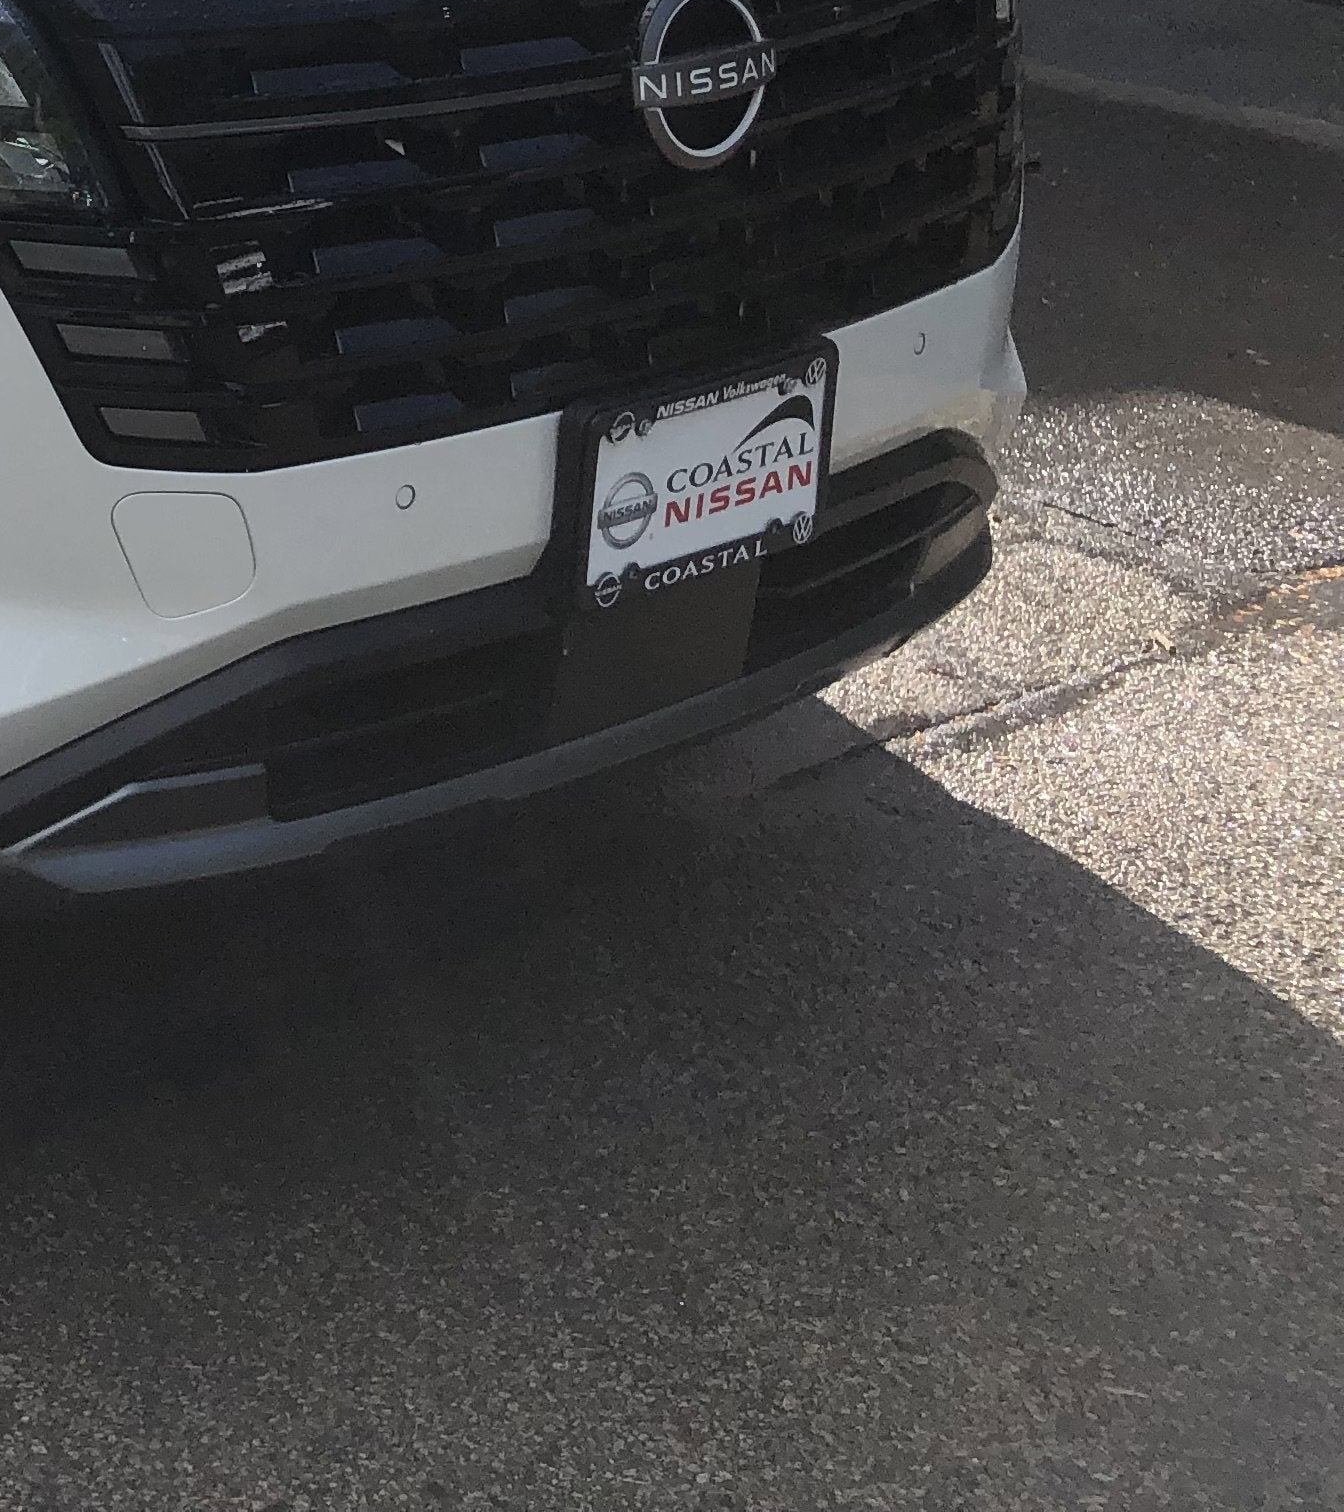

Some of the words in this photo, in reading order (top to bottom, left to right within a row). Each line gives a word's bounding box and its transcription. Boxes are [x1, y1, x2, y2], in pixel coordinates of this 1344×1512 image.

[639, 47, 776, 101] NISSAN
[656, 390, 720, 419] NISSAN
[722, 373, 786, 401] Volkswagen
[666, 431, 814, 494] COASTAL
[602, 498, 652, 521] NISSAN
[664, 461, 812, 528] NISSAN
[644, 538, 768, 591] COASTAL
